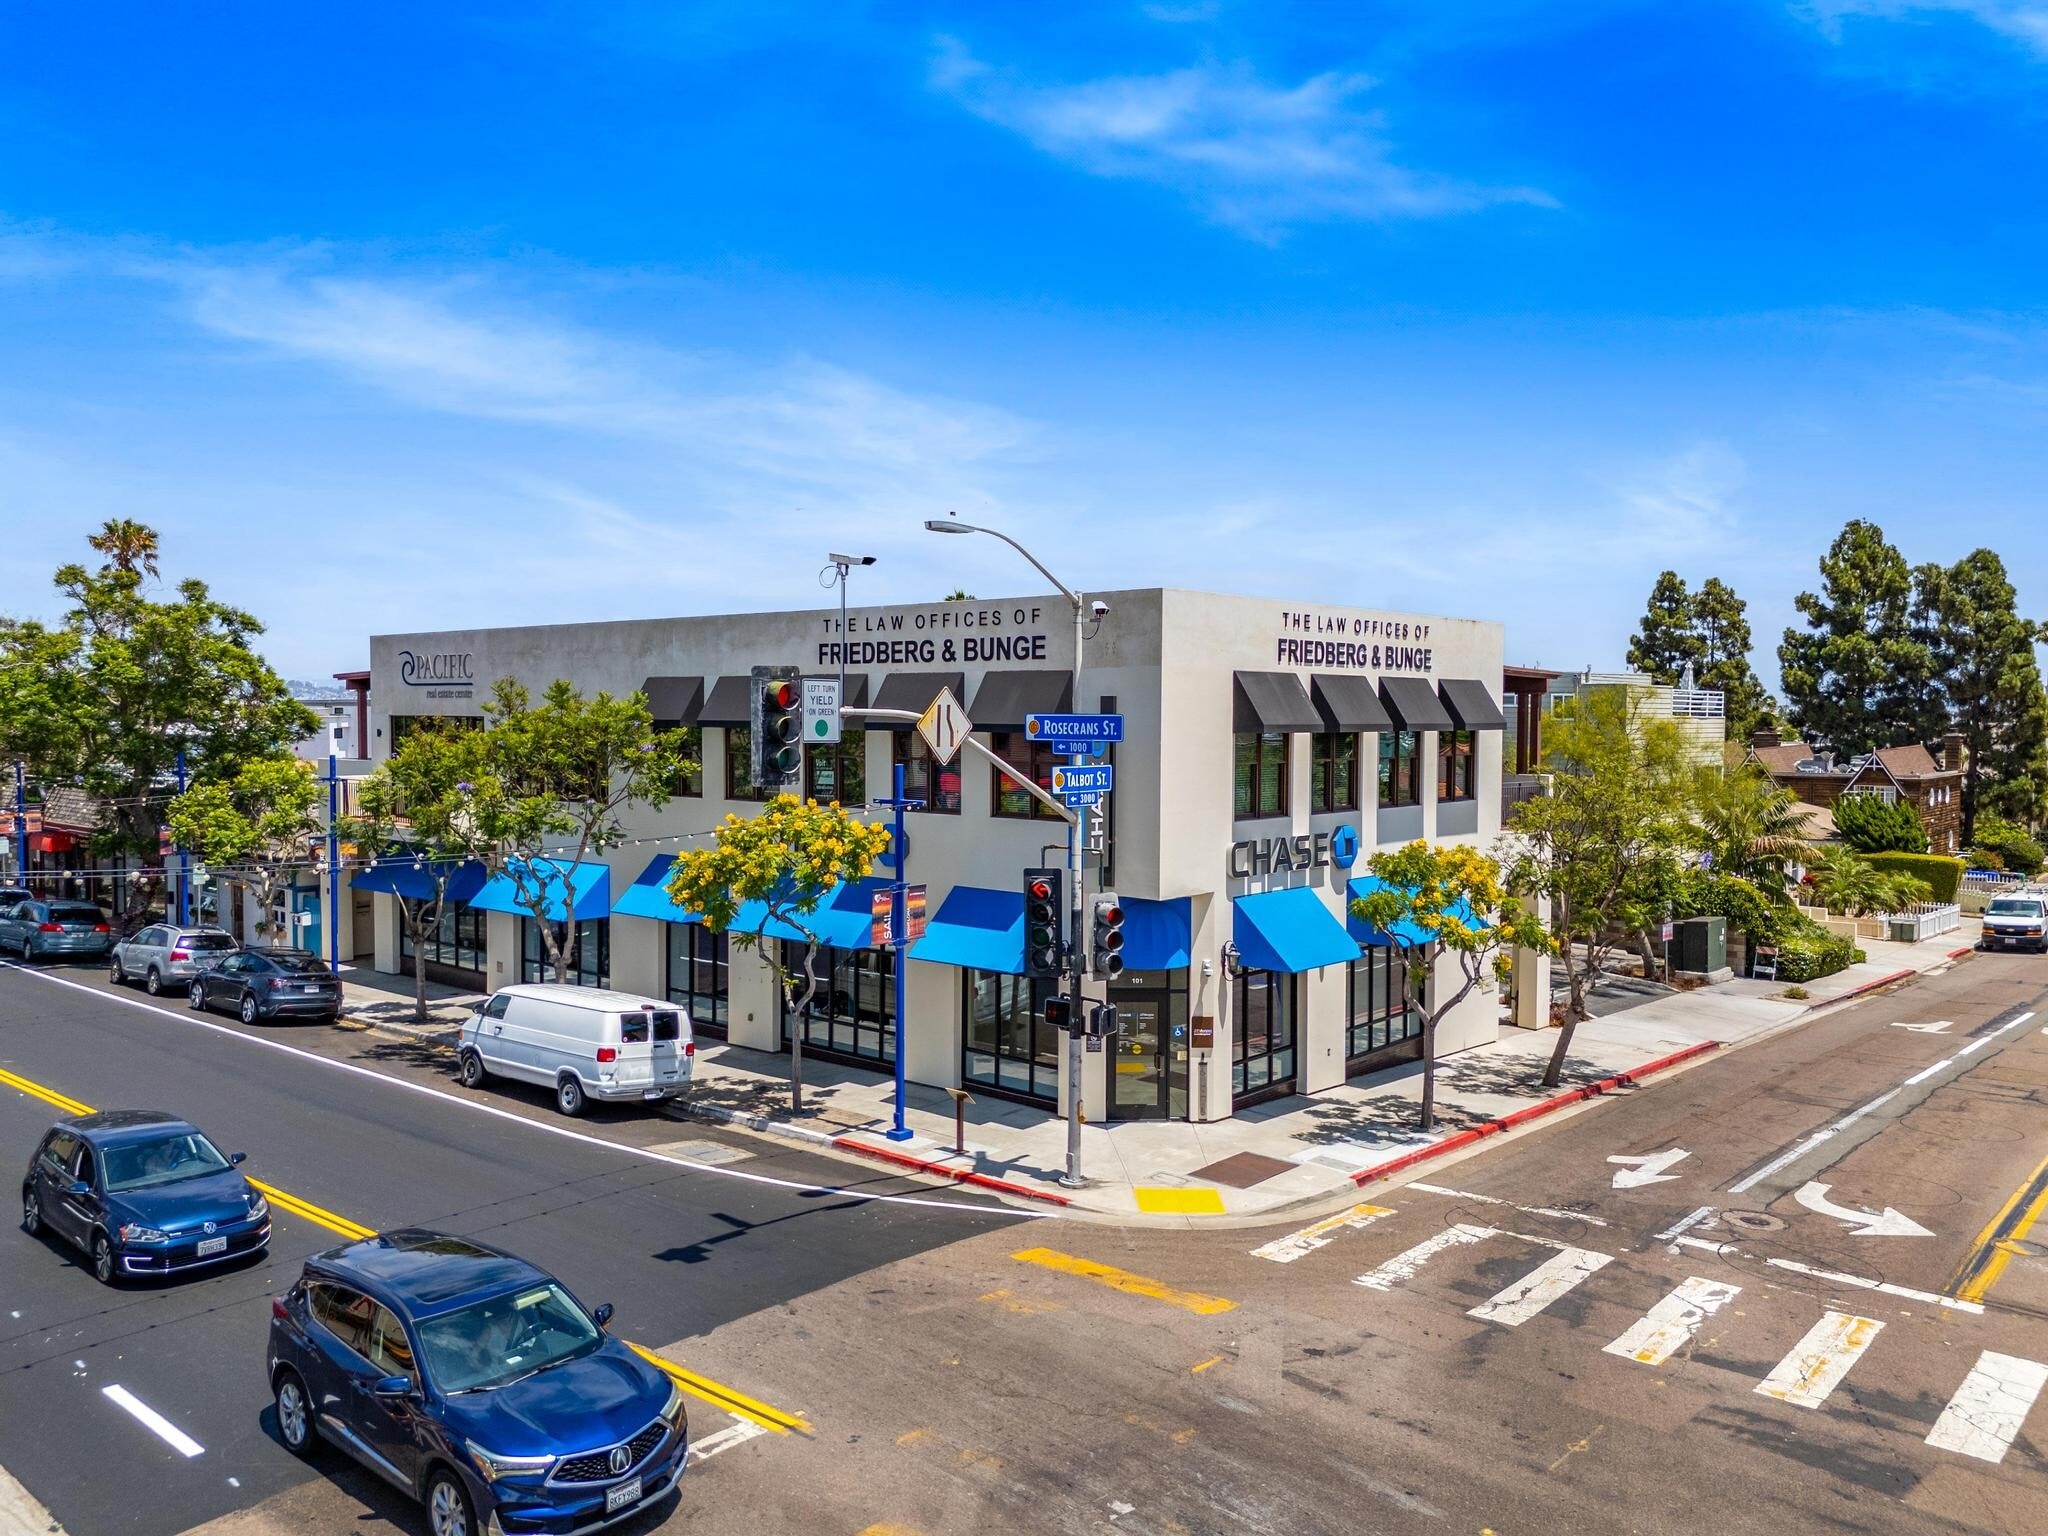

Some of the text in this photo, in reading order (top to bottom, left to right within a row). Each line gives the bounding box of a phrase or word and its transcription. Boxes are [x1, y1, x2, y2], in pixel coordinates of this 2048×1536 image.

[823, 608, 1041, 633] THE LAW OFFICES OF
[1283, 612, 1430, 641] THE LAW OFFICES OF
[818, 635, 1046, 665] FRIEDBERG & BUNGE
[1277, 638, 1432, 671] FRIEDBERG & BUNGE
[415, 653, 474, 680] PACIFIC
[822, 685, 836, 693] TURN
[810, 695, 834, 705] YIELD
[809, 708, 835, 716] ON GREEN
[1044, 720, 1118, 736] ROSECRANS ST.
[1069, 742, 1088, 752] 1000
[1066, 771, 1108, 788] TALBOT ST.
[1080, 793, 1096, 804] 3000
[1231, 832, 1331, 878] CHASE
[883, 910, 893, 939] SAIL
